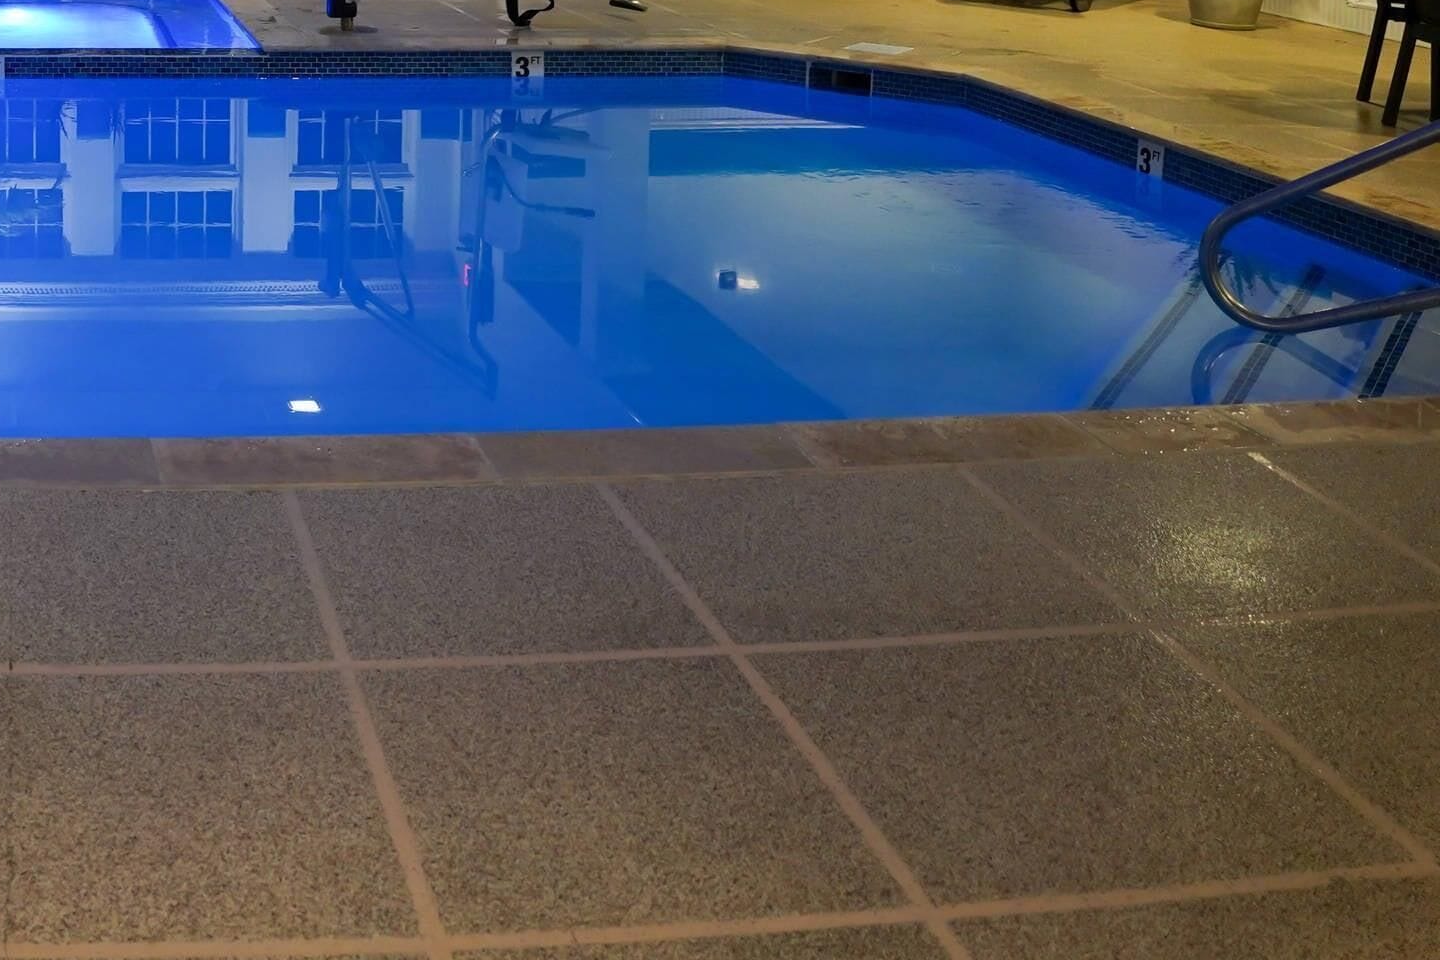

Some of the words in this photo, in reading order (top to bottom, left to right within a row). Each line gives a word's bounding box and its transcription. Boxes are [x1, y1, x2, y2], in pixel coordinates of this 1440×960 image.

[515, 56, 530, 78] 3
[530, 55, 542, 65] FT
[1139, 147, 1151, 174] 3
[1152, 150, 1160, 162] FT
